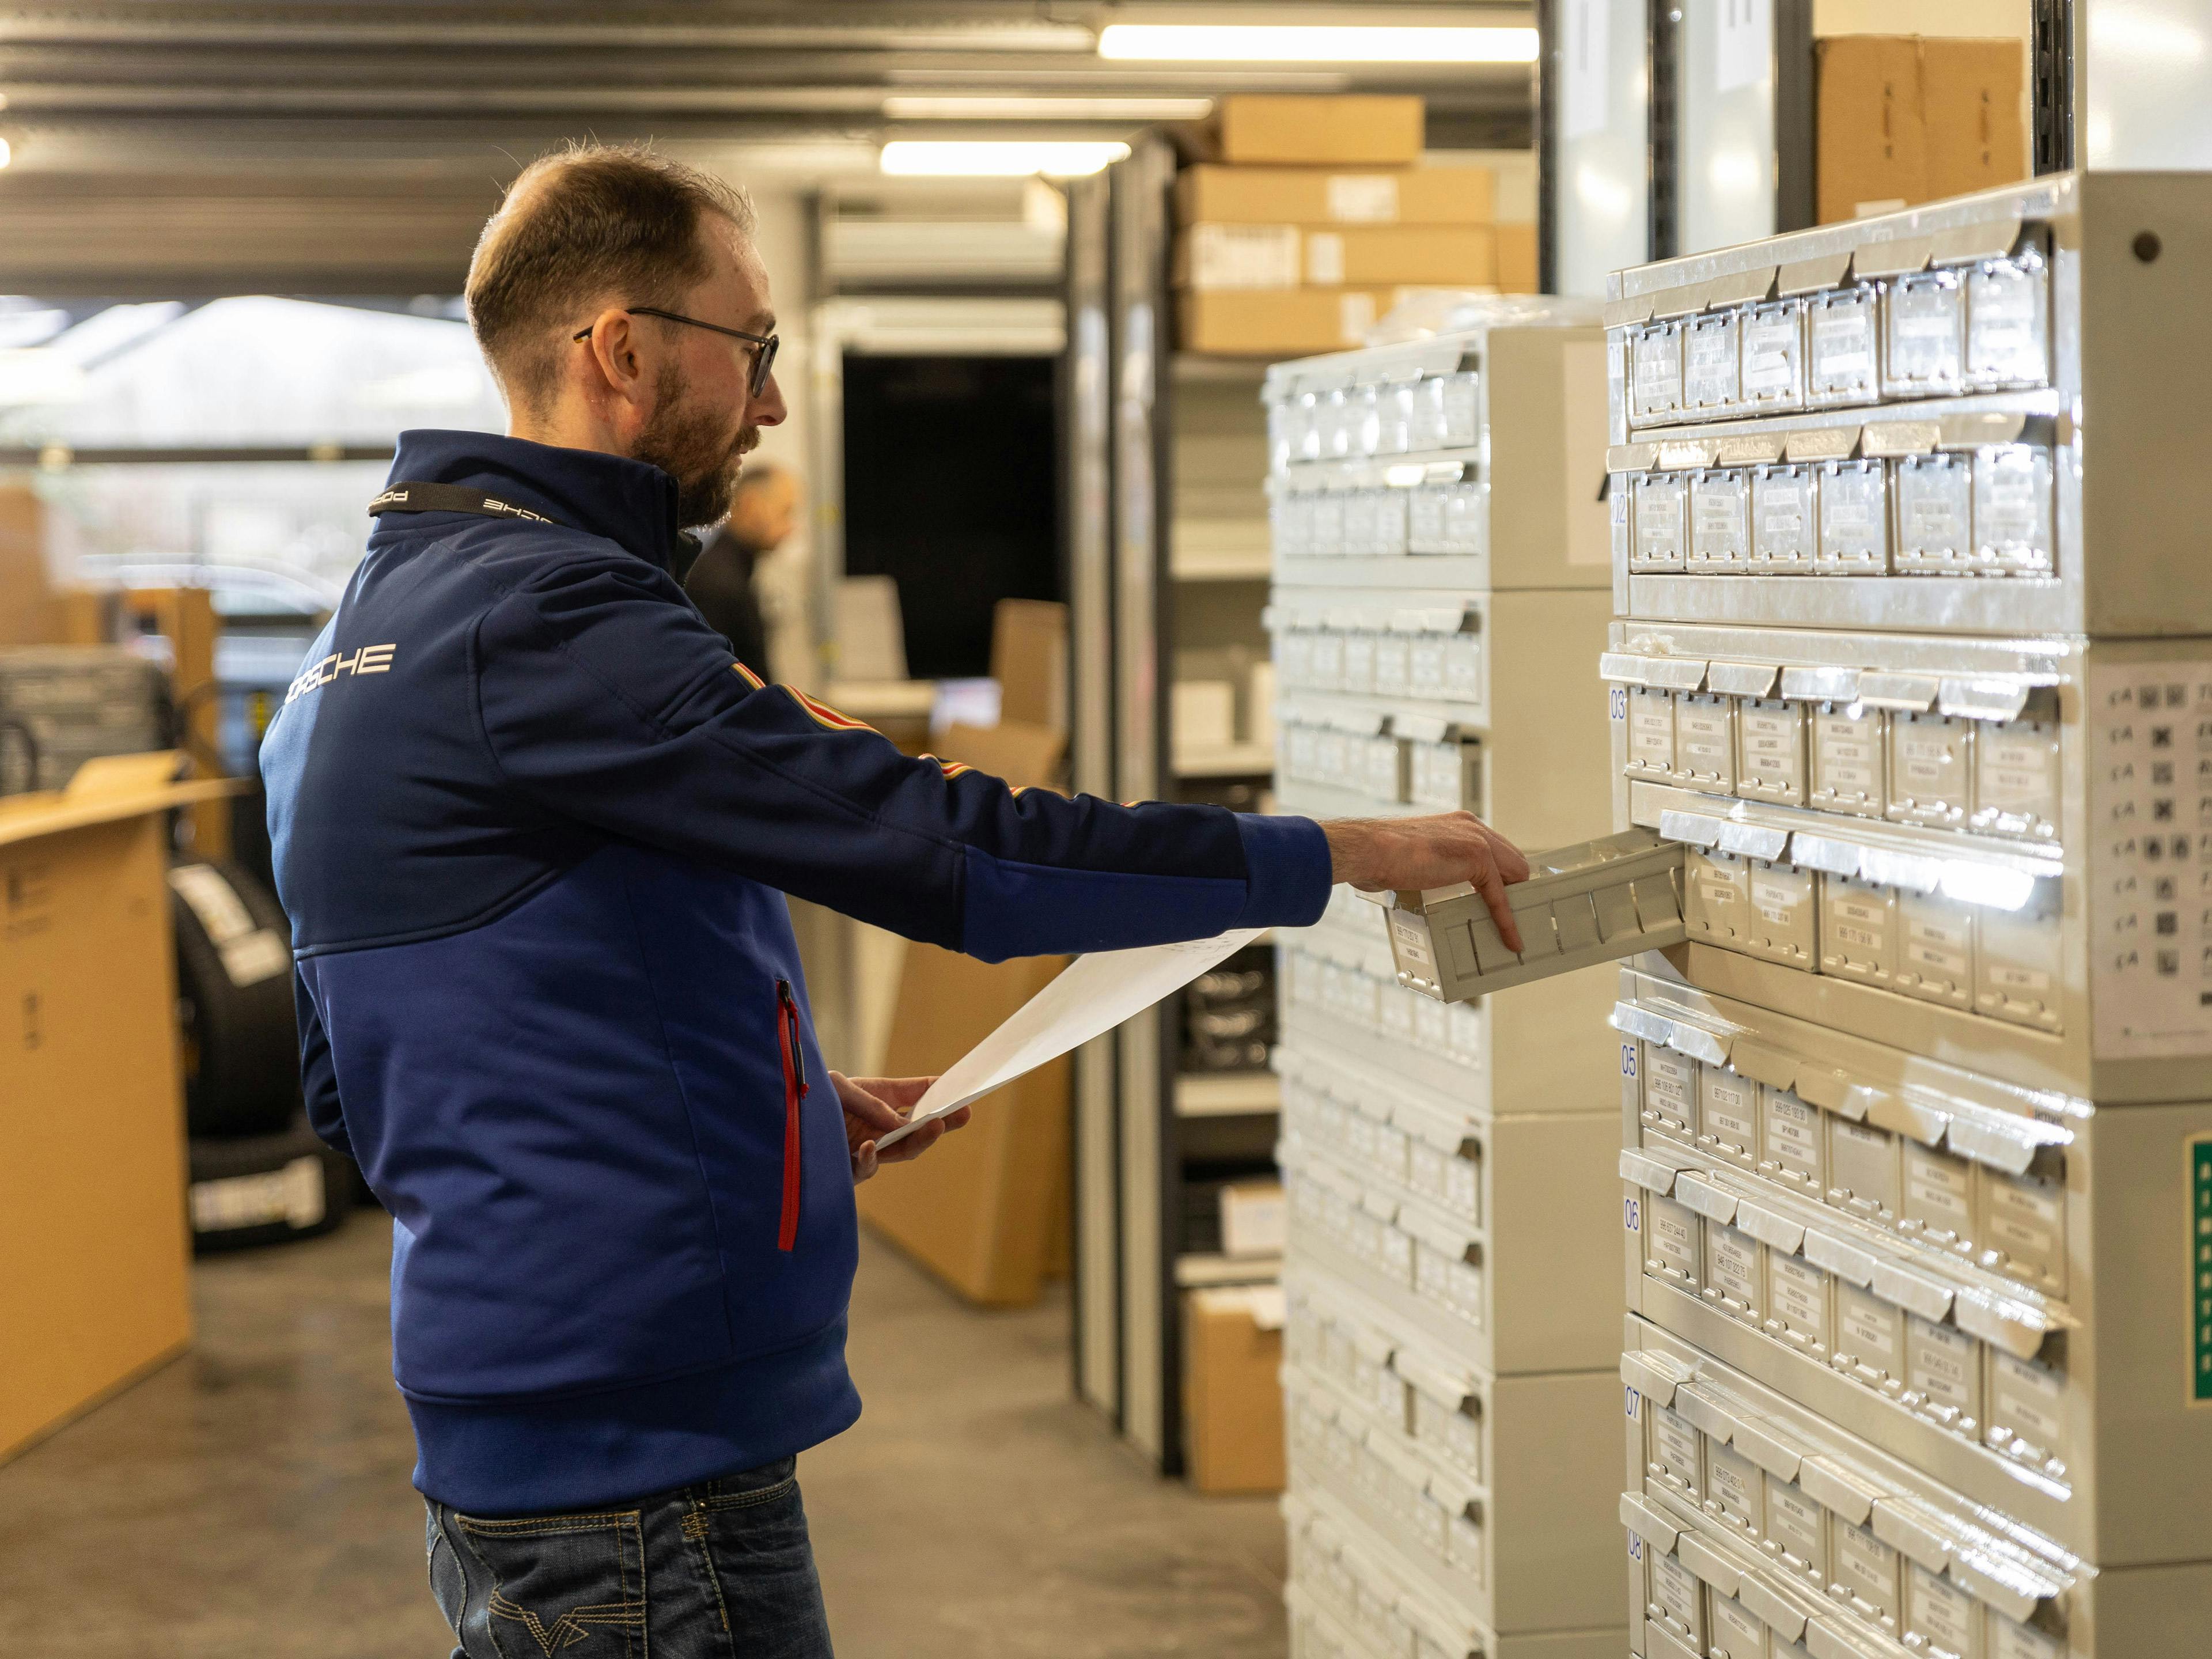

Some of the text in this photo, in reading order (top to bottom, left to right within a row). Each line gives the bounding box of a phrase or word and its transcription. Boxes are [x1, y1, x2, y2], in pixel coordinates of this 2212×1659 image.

[1609, 346, 1620, 374] 01
[369, 490, 408, 507] POR
[483, 498, 553, 524] CHE
[1612, 494, 1626, 523] 02
[285, 643, 396, 704] ORSCHE
[1611, 689, 1624, 719] 03
[1622, 1045, 1635, 1076] 05
[1626, 1199, 1638, 1230] 06
[1626, 1387, 1639, 1418] 07
[1629, 1529, 1641, 1560] 08
